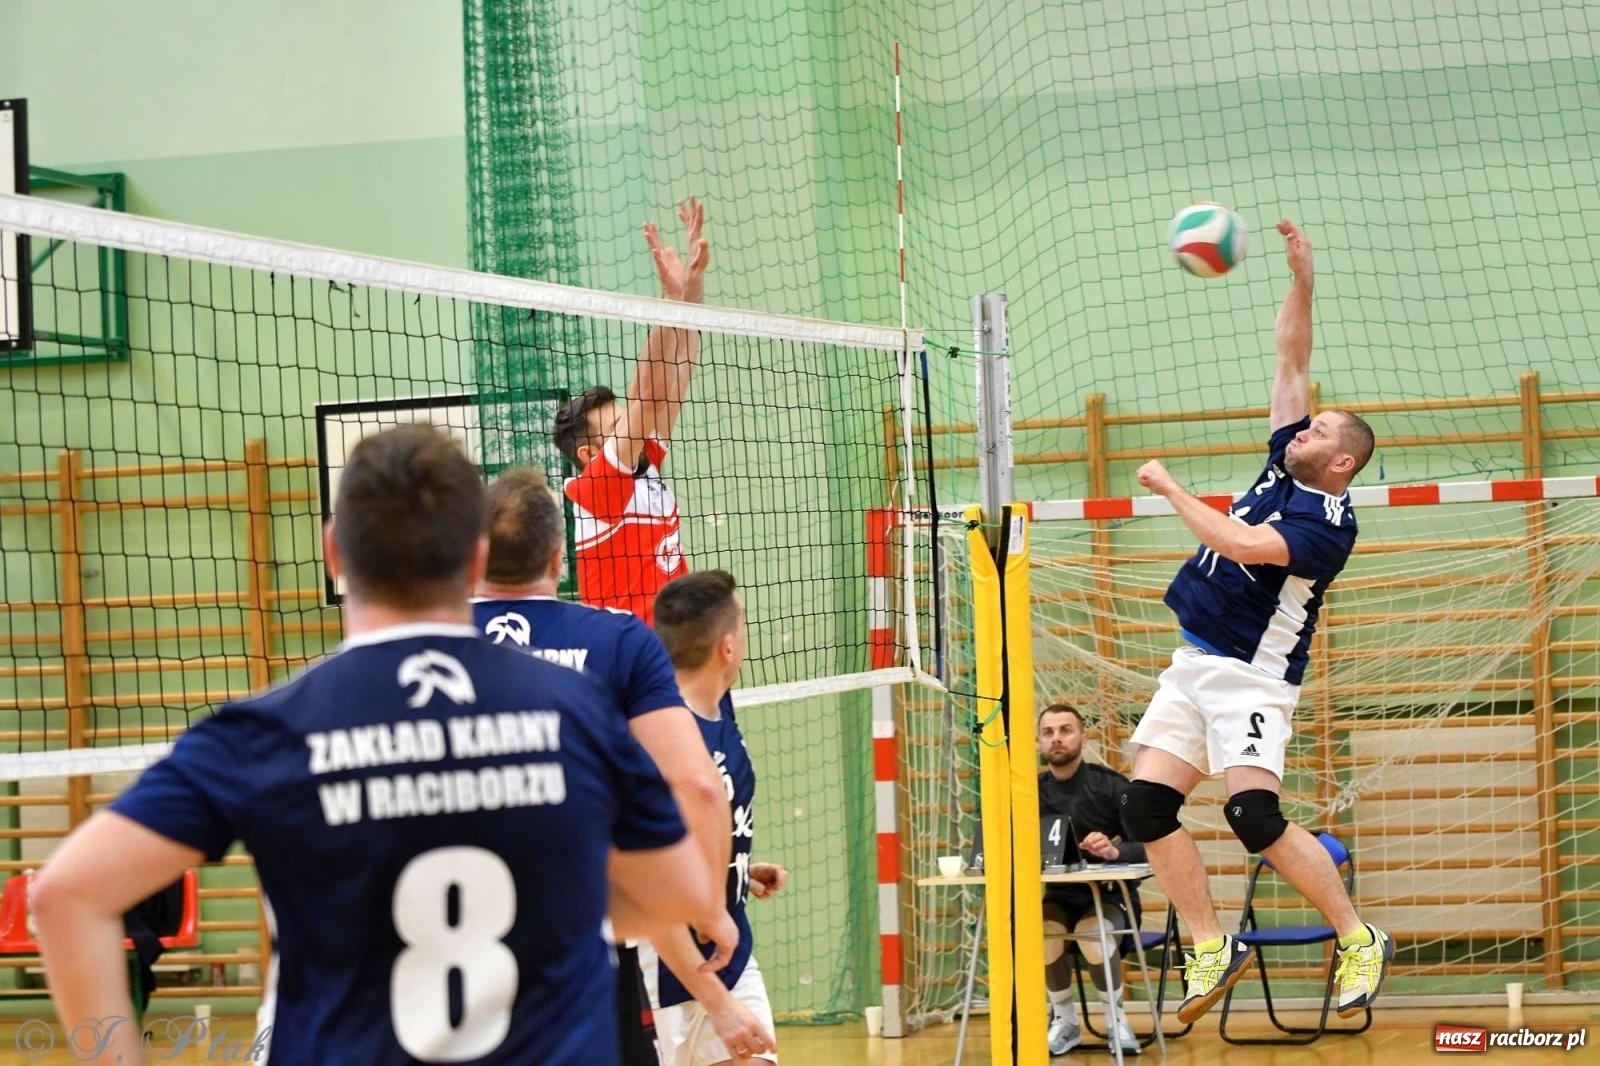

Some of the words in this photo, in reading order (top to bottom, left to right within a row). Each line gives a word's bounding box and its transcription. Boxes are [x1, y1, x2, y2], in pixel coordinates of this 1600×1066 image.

[1255, 470, 1276, 496] 2
[306, 720, 446, 774] ZAKŁAD
[447, 710, 561, 759] KARNY
[318, 779, 362, 826] W
[366, 762, 566, 820] RACIBORZU
[1048, 818, 1061, 847] 4
[390, 845, 520, 1064] 8
